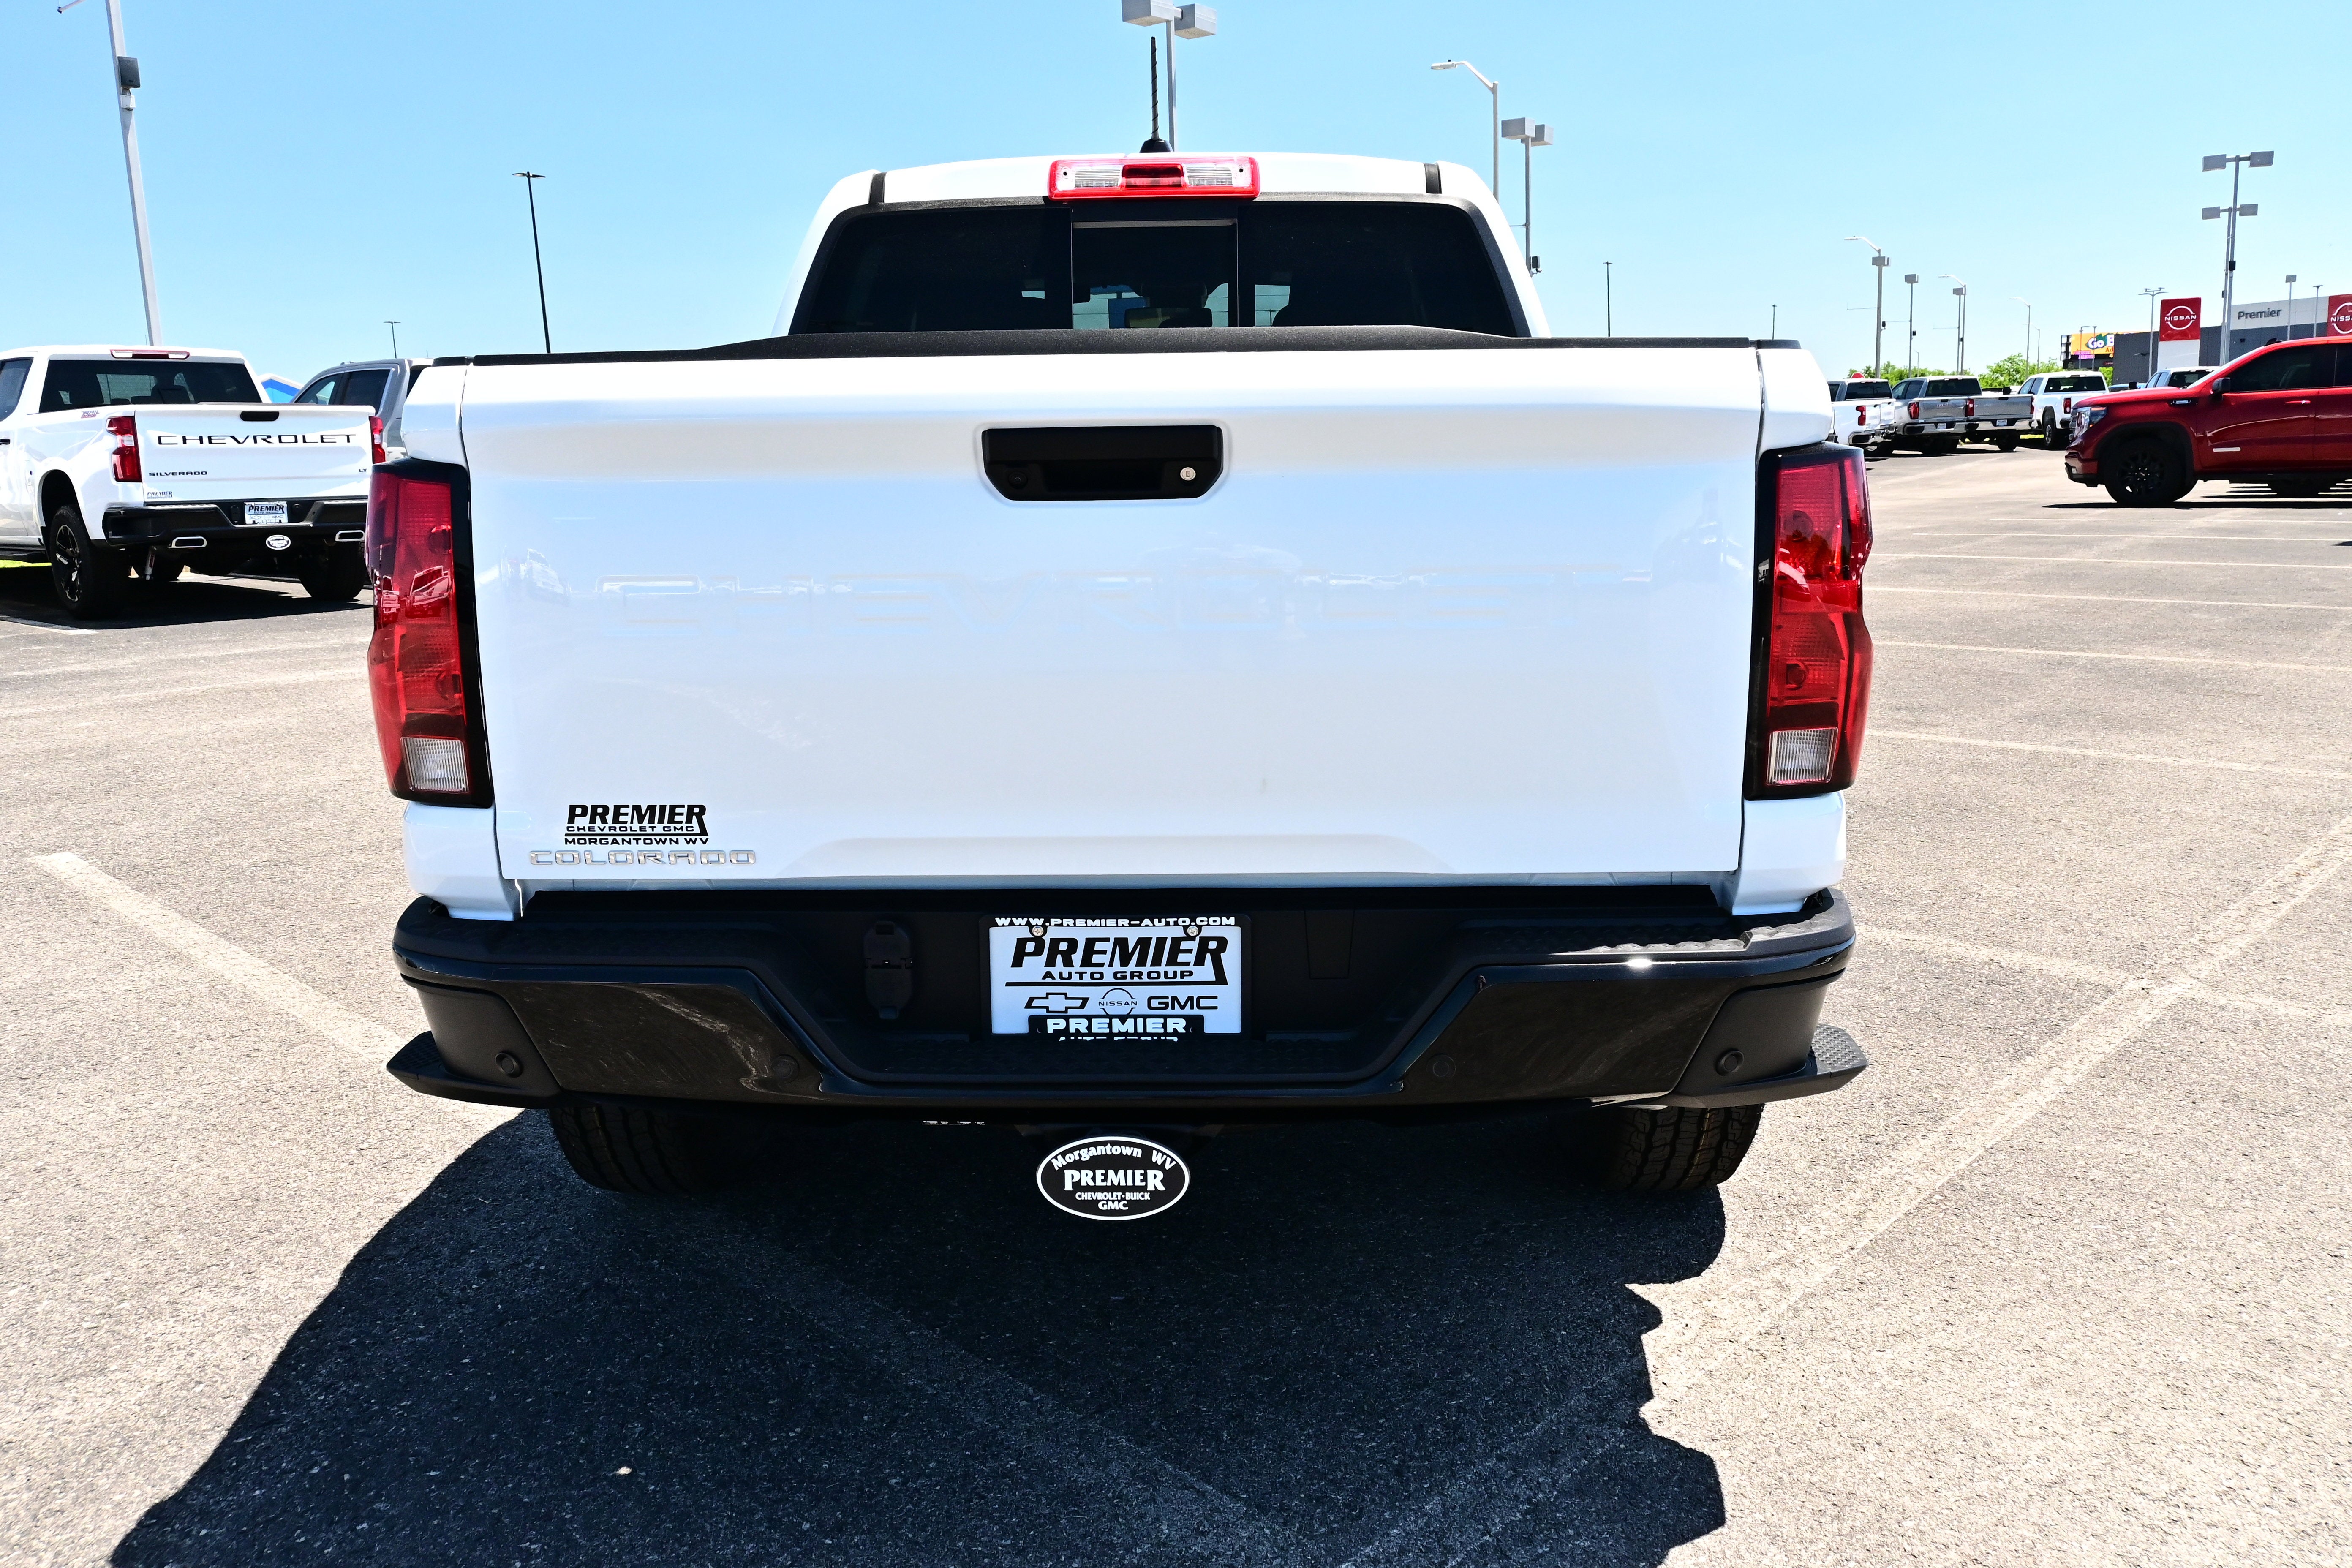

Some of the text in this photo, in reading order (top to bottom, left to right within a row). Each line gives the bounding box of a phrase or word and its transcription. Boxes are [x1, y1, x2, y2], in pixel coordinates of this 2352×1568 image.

[2238, 308, 2281, 320] Premier
[2088, 338, 2104, 348] Go
[158, 434, 356, 445] CHEVROLET
[248, 505, 285, 514] PREMIER
[596, 564, 1622, 635] CHEVROLET
[567, 804, 709, 836] PREMIER
[565, 837, 709, 845] MORGANTOWN WV
[529, 849, 757, 865] COLORADO
[995, 917, 1235, 927] WWW.PREMIER-AUTO.COM
[1010, 936, 1229, 985] PREMIER
[1041, 970, 1194, 980] AUTO GROUP
[1147, 995, 1218, 1010] GMC
[1047, 1018, 1186, 1033] PREMIER
[1051, 1143, 1176, 1171] Morgantown WV
[1064, 1169, 1166, 1191] PREMIER
[1098, 1200, 1129, 1210] GMC
